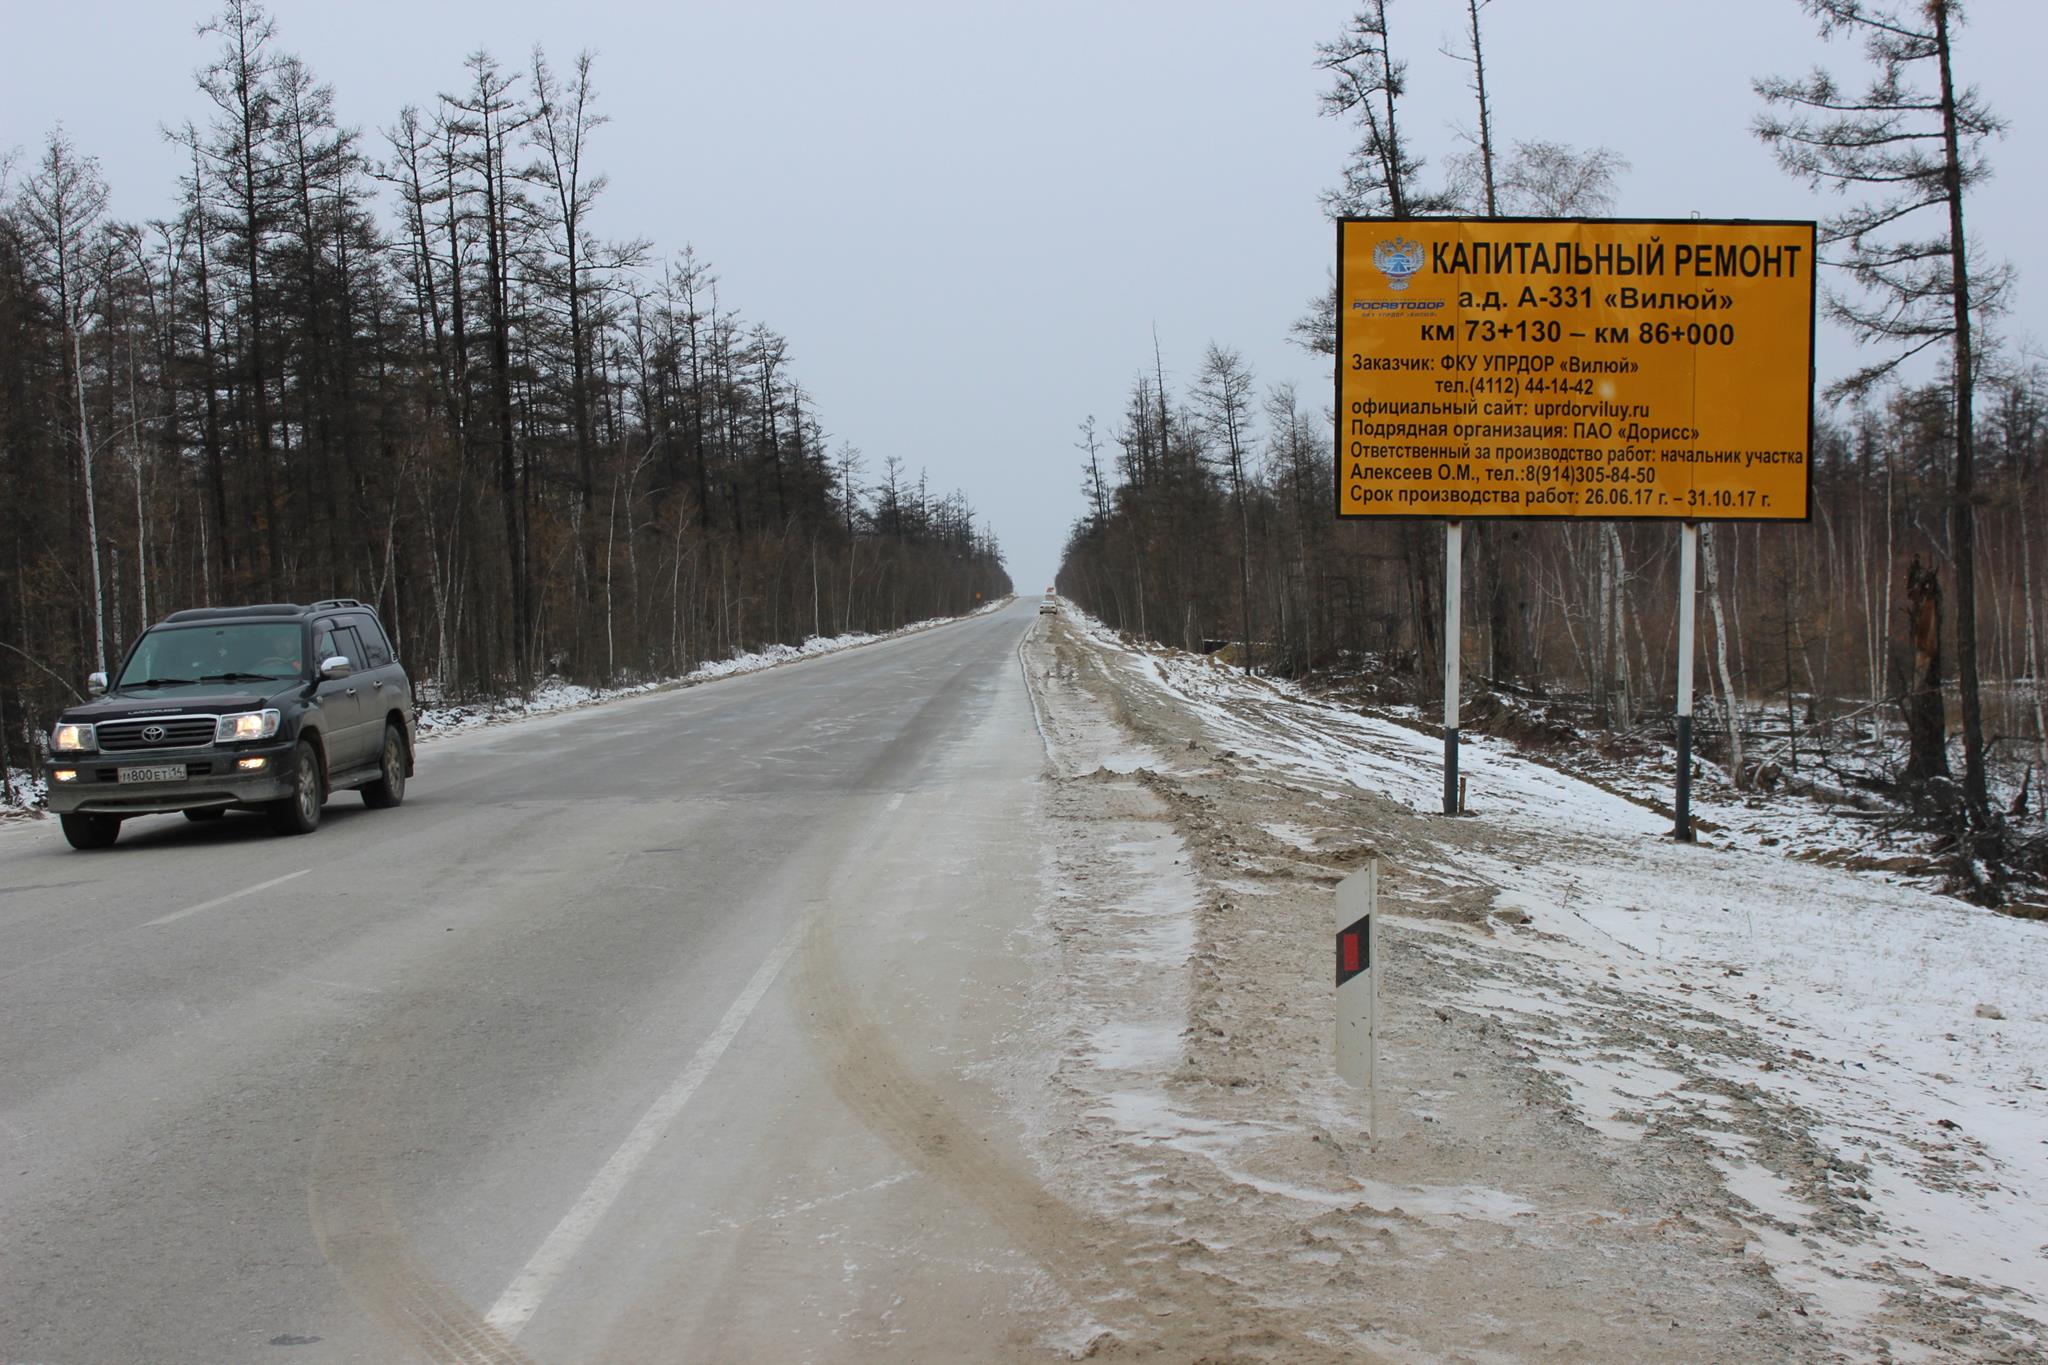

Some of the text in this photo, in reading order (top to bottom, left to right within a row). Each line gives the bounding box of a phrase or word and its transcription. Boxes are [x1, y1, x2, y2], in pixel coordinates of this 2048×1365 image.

[1433, 236, 1802, 278] КАПИТАЛЬНЫЙ РЕМОНТ
[1352, 302, 1445, 310] РОСАВТОДОР
[1458, 286, 1733, 311] а.д. А-331 «Вилюй»
[1421, 325, 1455, 341] км
[1465, 320, 1561, 342] 73+130
[1595, 327, 1629, 344] км
[1639, 322, 1734, 345] 86+000
[1352, 354, 1638, 375] Заказчик: ФКУ УПРДОР «Вилюй»
[1435, 377, 1593, 400] тел.(4112) 44-14-42
[1352, 399, 1649, 421] официальный сайт: uprdorviluy.ru
[1352, 420, 1699, 443] Подрядная организация: ПАО «Дорисс»
[1351, 442, 1803, 467] Ответственный за производство работ: начальник участка
[1351, 463, 1655, 486] Алексеев О.М., тел.:8(914)305-84-50
[1351, 486, 1393, 505] Срок
[1399, 490, 1519, 505] производства
[1526, 487, 1579, 507] работ:
[1585, 488, 1653, 504] 26.06.17
[1659, 493, 1667, 505] г.
[1688, 489, 1756, 506] 31.10.17
[1762, 495, 1770, 507] г.
